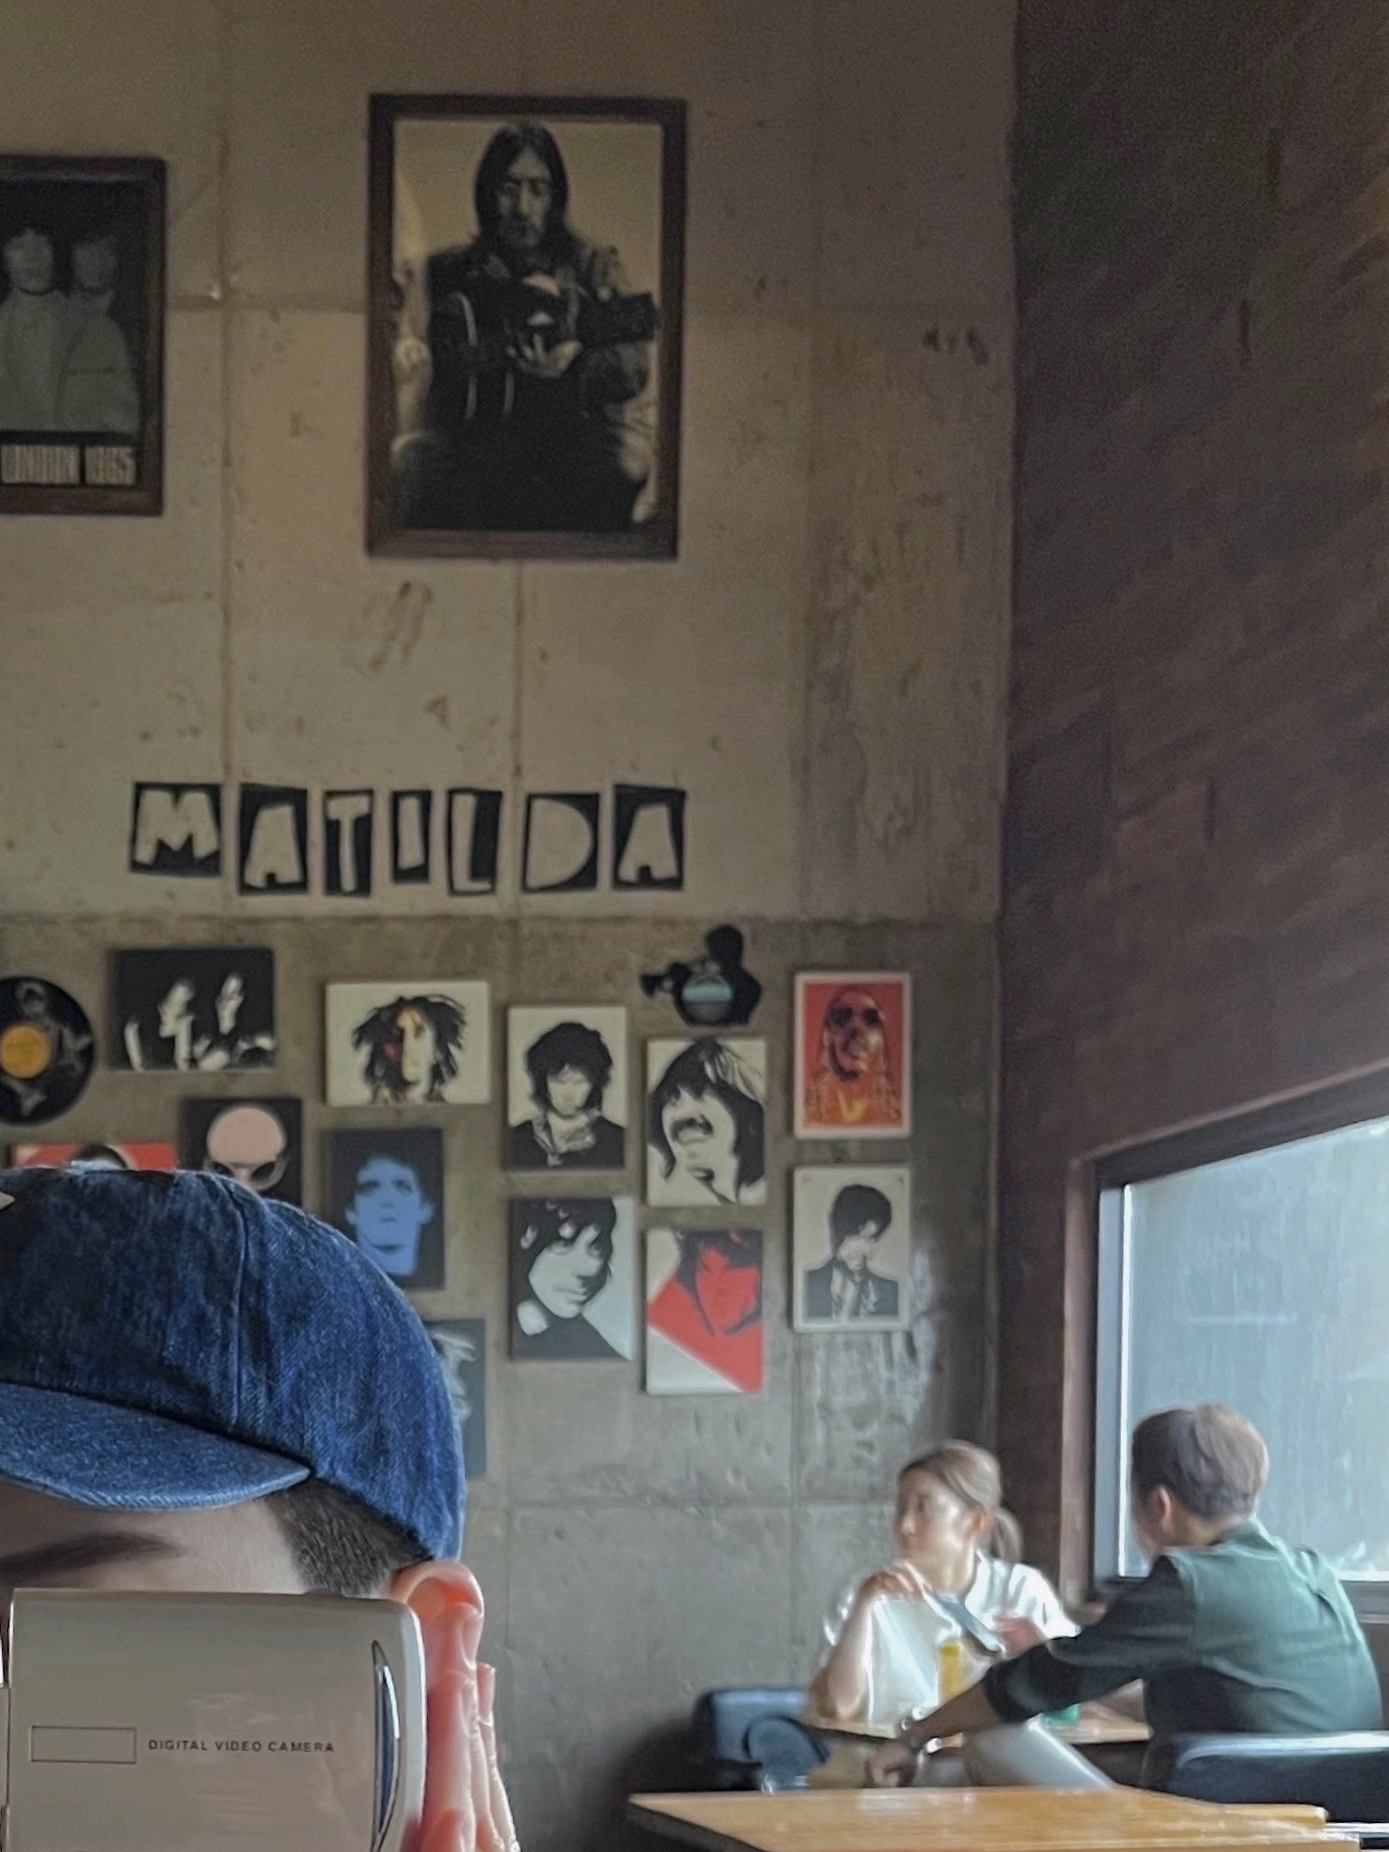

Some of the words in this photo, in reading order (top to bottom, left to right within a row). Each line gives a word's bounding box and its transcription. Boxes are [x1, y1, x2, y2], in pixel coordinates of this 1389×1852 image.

[130, 782, 686, 896] MATILDA
[148, 1739, 208, 1752] DIGITAL
[214, 1740, 262, 1753] VIDEO
[267, 1741, 335, 1753] CAMERA
